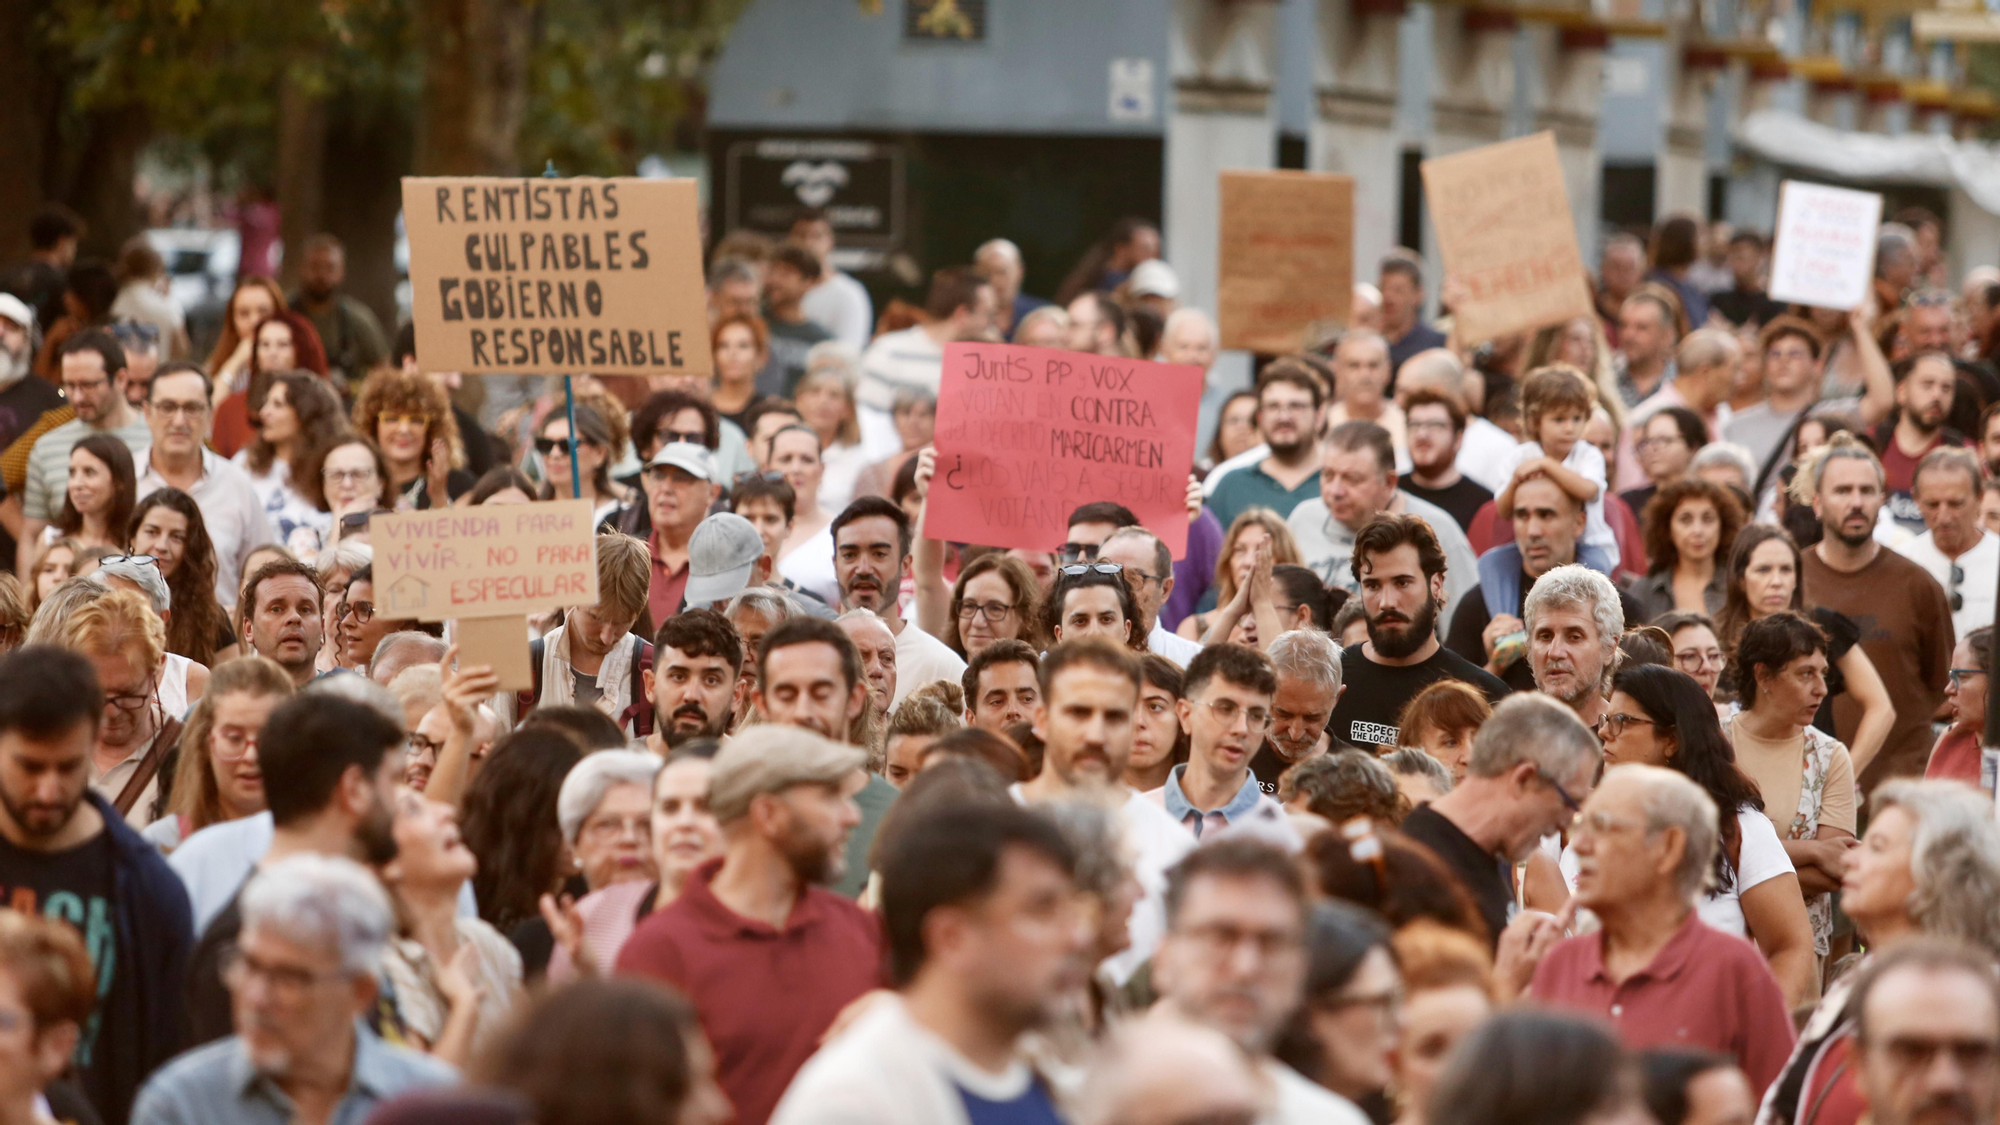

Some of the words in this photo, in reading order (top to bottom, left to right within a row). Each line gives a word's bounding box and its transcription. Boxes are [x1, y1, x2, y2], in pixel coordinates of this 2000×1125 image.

[465, 230, 650, 271] CULPABLES
[471, 327, 684, 367] RESPONSABLE
[1046, 359, 1073, 386] PP
[1090, 364, 1135, 394] VOX
[959, 387, 1026, 417] VOTAN
[1071, 395, 1156, 428] CONTRA
[1077, 466, 1094, 496] A
[385, 517, 500, 540] VIVIENDA
[516, 513, 574, 534] PARA
[978, 495, 1075, 533] VOTAND
[486, 545, 518, 567] NO
[537, 543, 590, 564] PARA
[451, 572, 588, 604] ESPECULAR
[1352, 722, 1399, 737] RESPECT
[1352, 731, 1367, 740] THE
